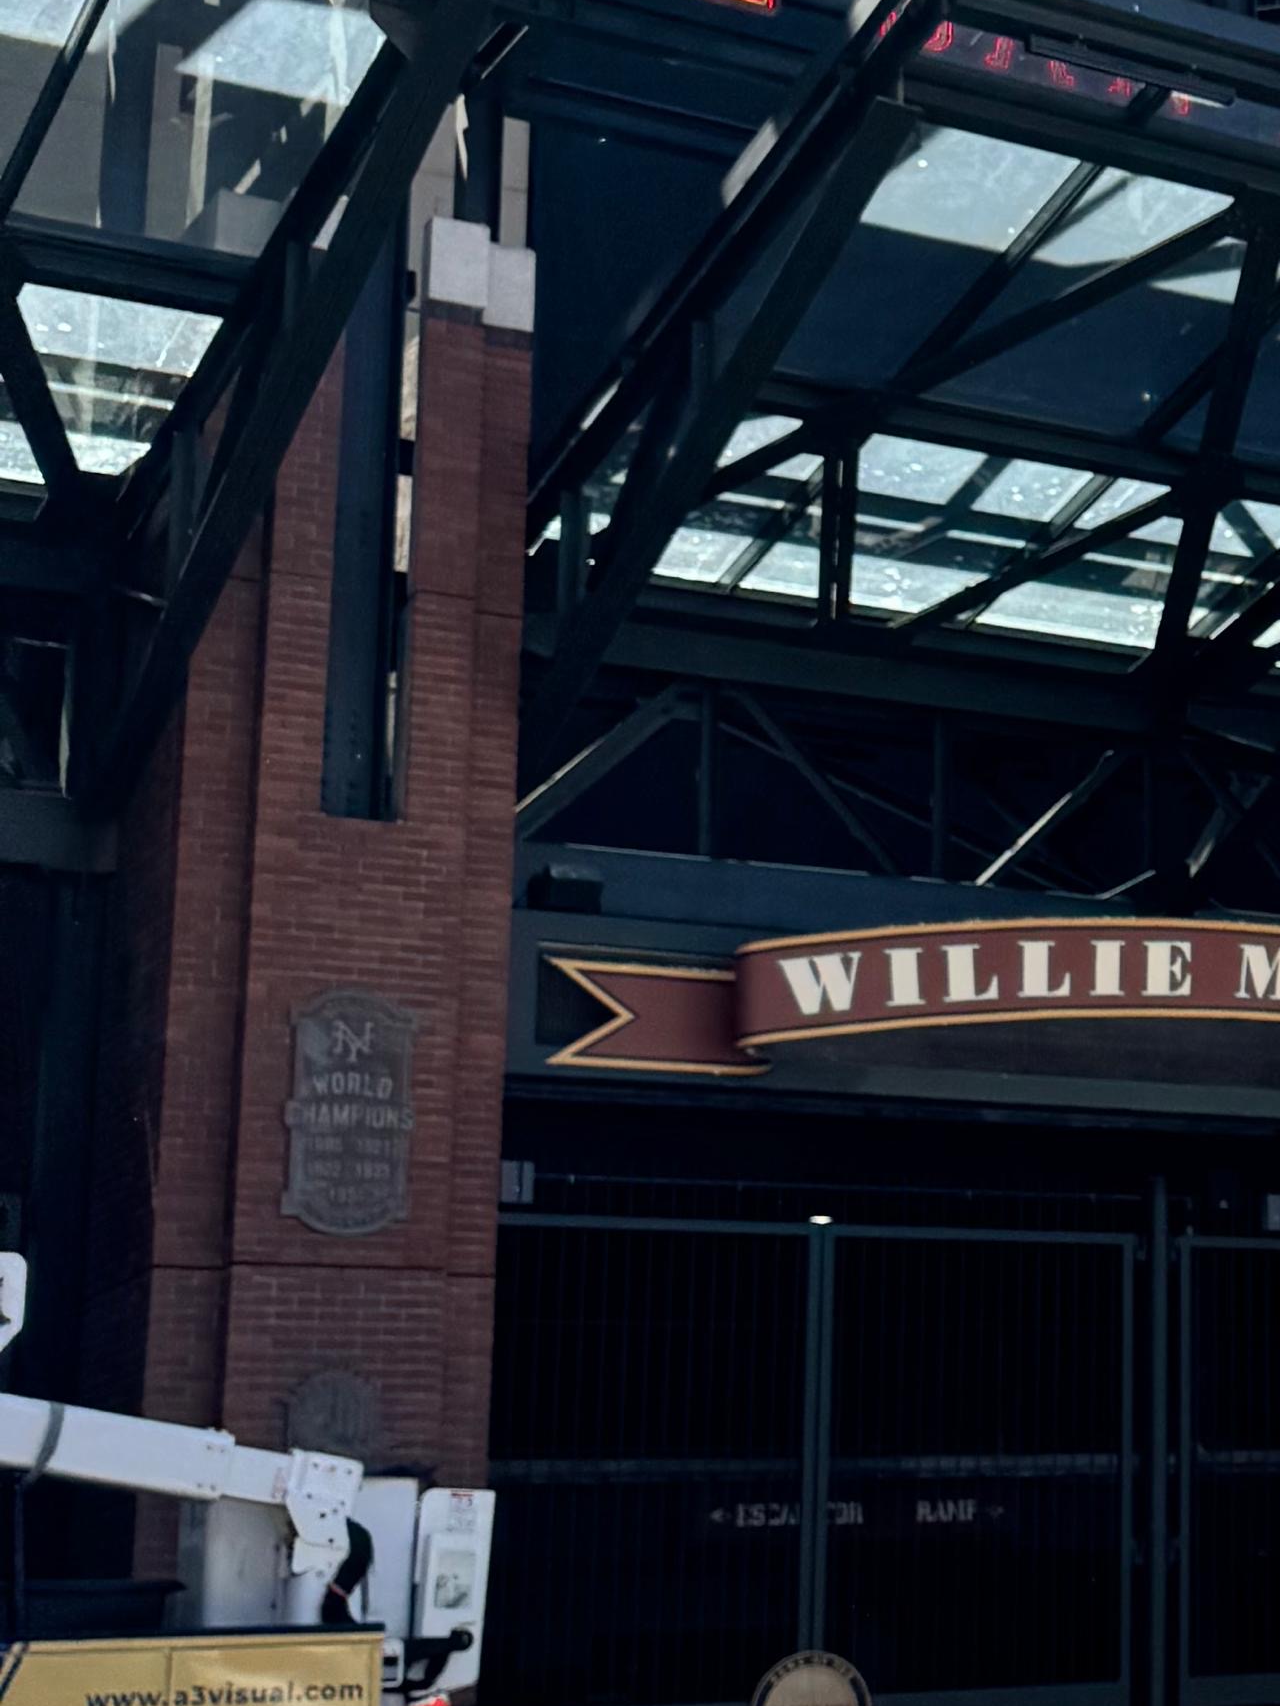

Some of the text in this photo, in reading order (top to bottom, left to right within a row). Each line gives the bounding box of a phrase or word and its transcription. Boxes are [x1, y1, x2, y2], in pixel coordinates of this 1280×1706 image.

[777, 938, 1194, 1019] WILLIE
[312, 1071, 394, 1100] WORLD
[286, 1101, 414, 1131] CHAMPIONS
